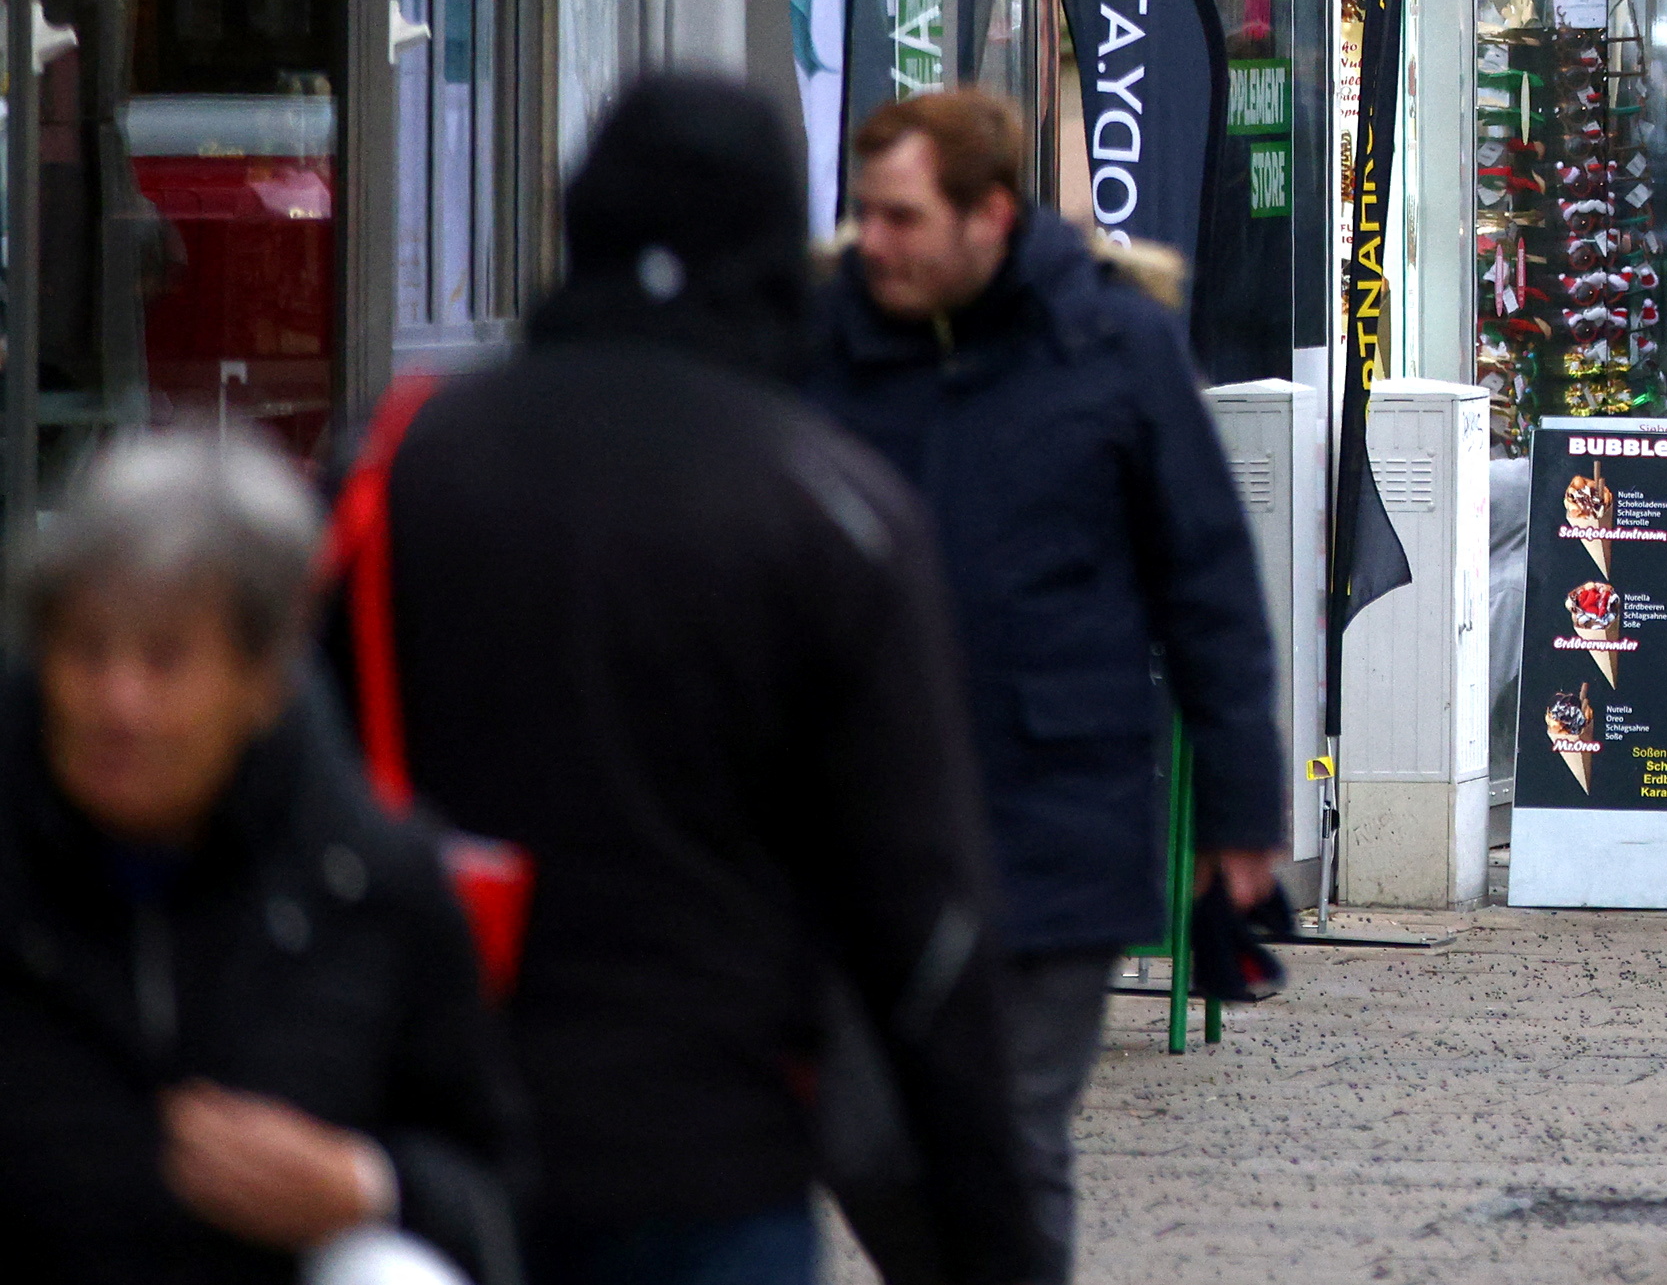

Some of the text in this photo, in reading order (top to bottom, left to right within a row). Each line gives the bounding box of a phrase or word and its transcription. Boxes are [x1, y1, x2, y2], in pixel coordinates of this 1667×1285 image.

[1252, 151, 1285, 210] STORE
[1618, 491, 1644, 499] Nutella
[1617, 509, 1661, 518] Schlagsahne
[1617, 518, 1650, 526] Keksrolle
[1558, 525, 1667, 542] Schokoladentraum
[1624, 593, 1650, 602] Nutella
[1623, 612, 1667, 621] Schlagsahne
[1623, 620, 1641, 629] Soße
[1553, 635, 1639, 652] Erdbeerwunder
[1606, 705, 1633, 714] Nutella
[1606, 715, 1624, 723] Oreo
[1605, 724, 1650, 733] Schlagsahne
[1605, 733, 1623, 741] Soße
